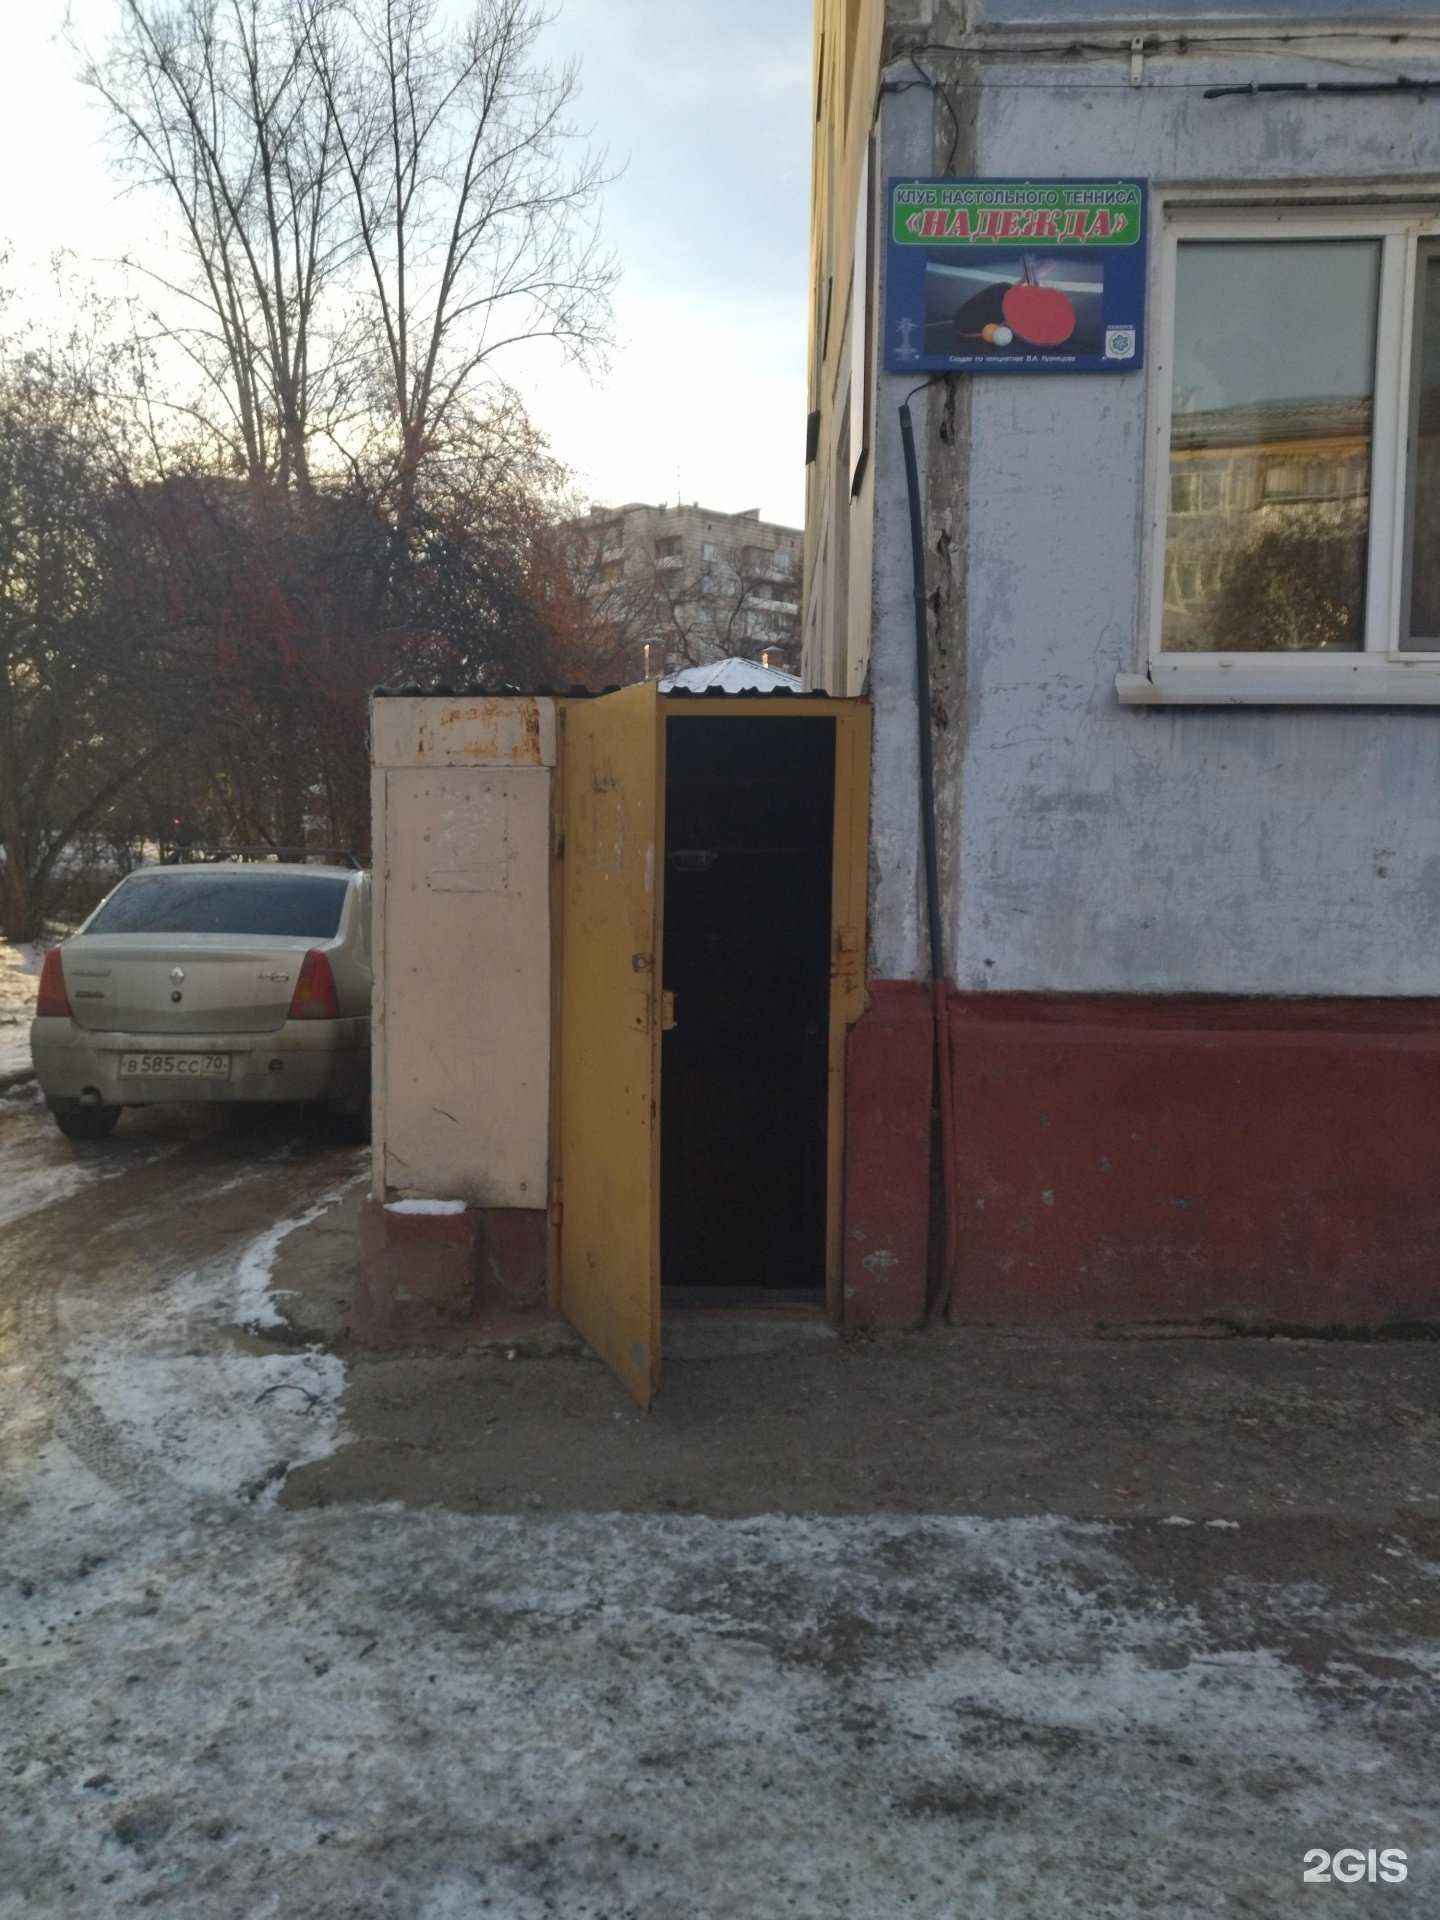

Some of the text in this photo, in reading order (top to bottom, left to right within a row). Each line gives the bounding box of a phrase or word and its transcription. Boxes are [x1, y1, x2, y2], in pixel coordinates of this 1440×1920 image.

[896, 191, 1137, 205] КЛУБ НАСТОЛЬНОГО ТЕННИСА
[904, 208, 1129, 243] «НАДЕЖДА»
